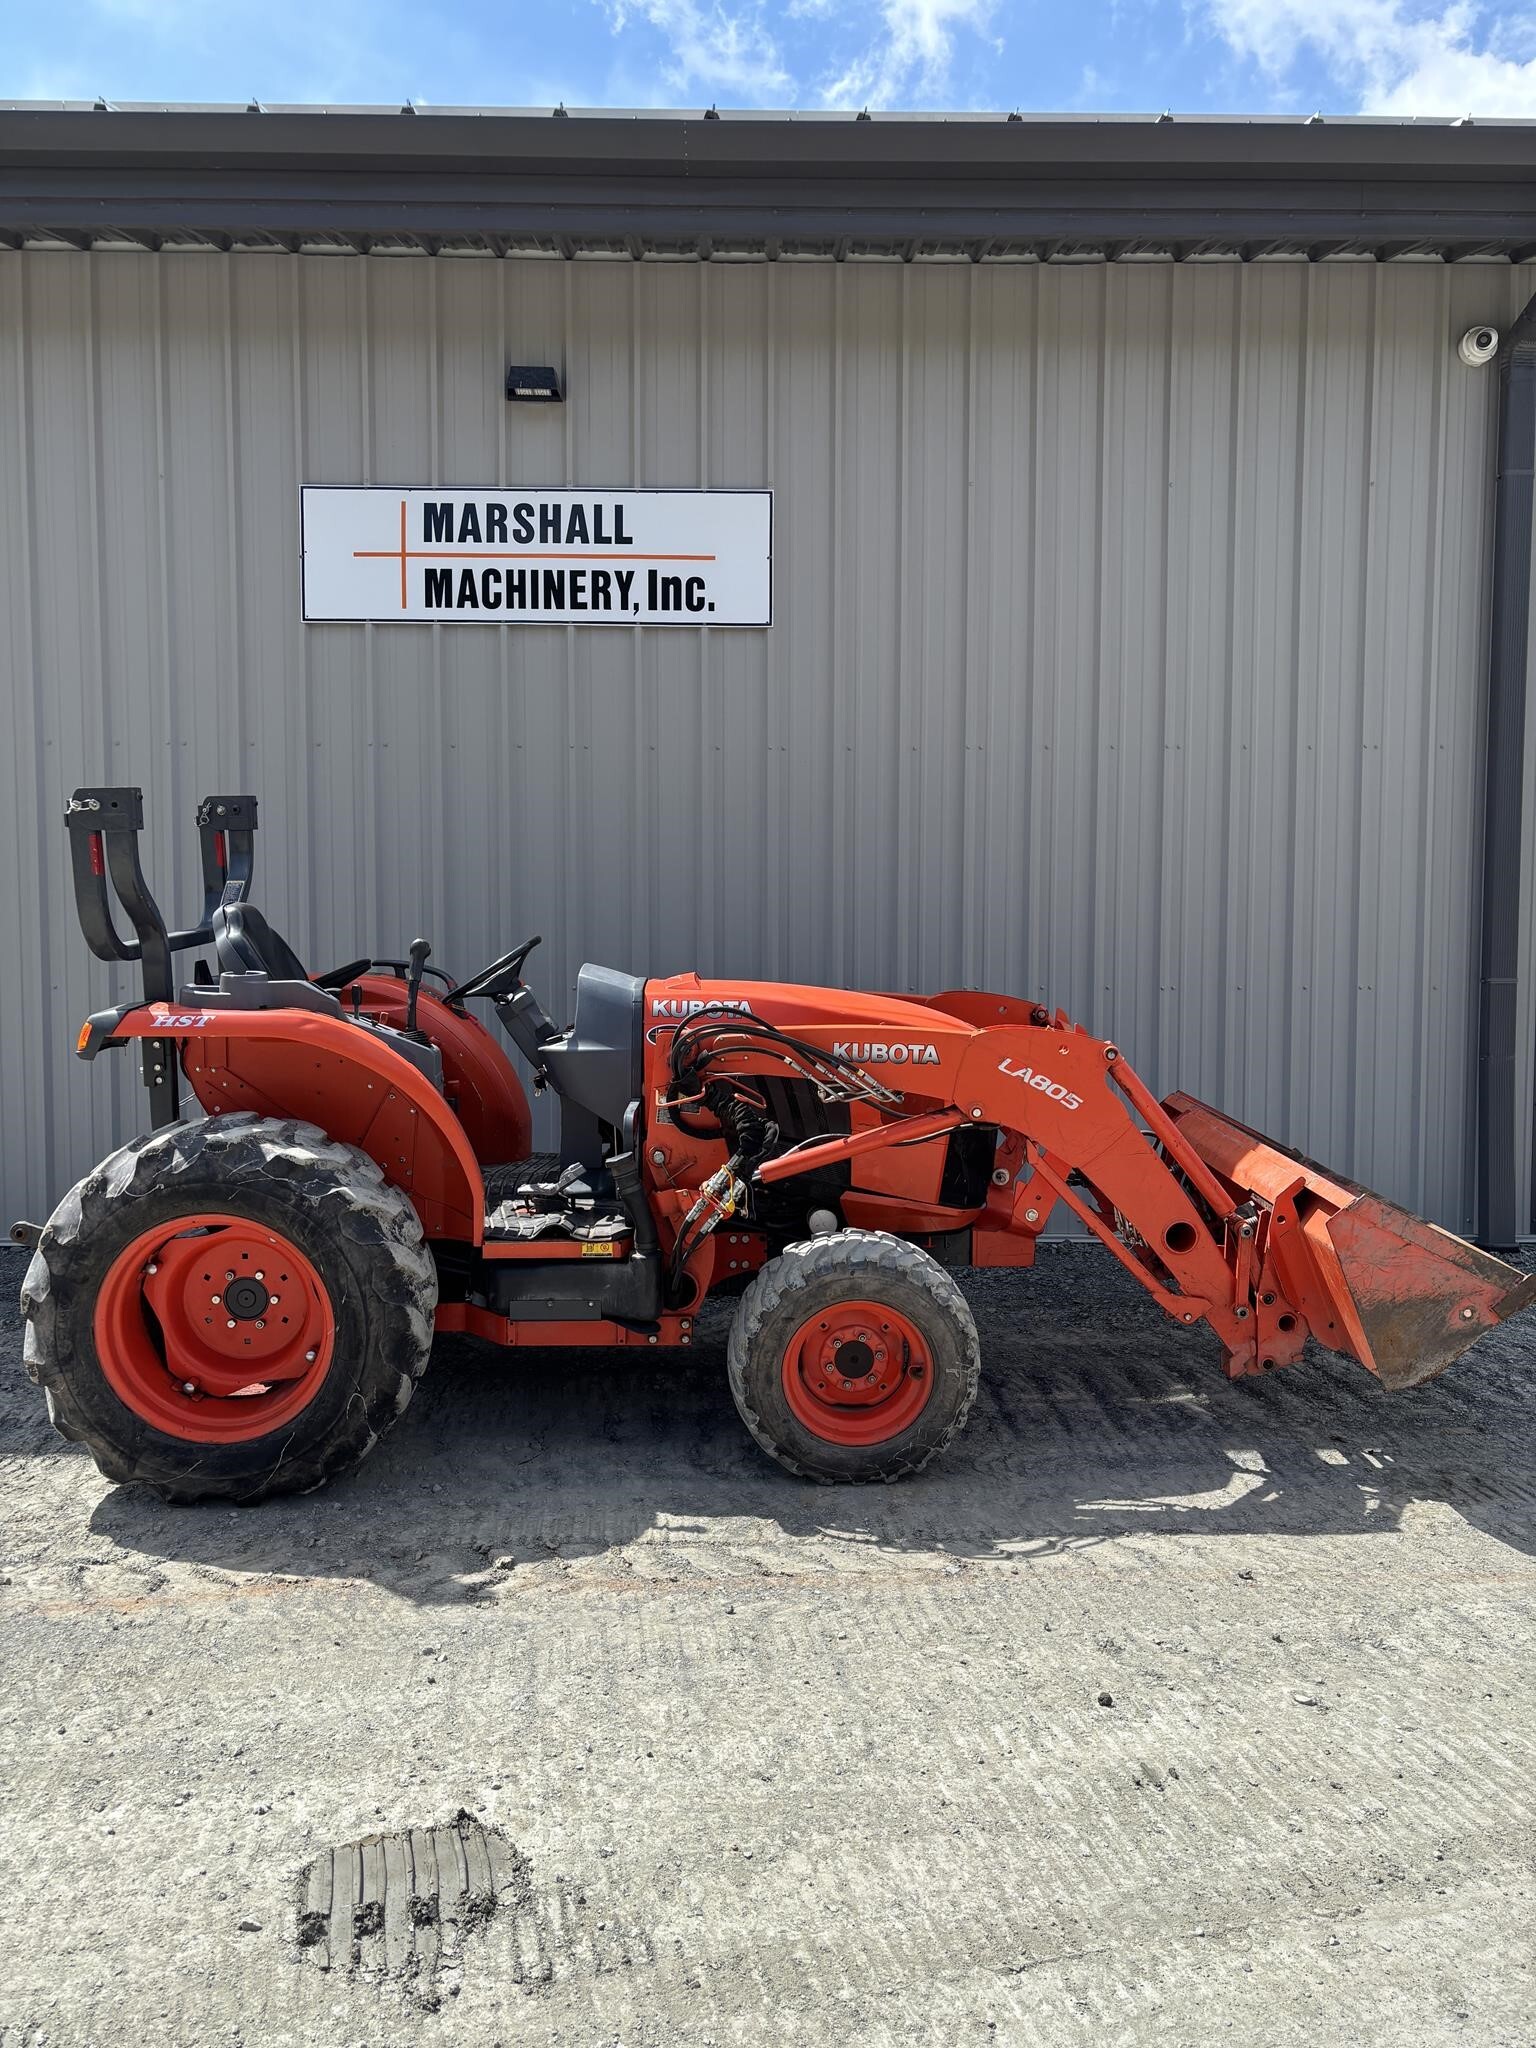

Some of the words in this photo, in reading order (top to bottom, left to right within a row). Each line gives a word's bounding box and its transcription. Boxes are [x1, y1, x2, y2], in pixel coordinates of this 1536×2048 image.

[423, 502, 633, 545] MARSHALL
[424, 568, 640, 616] MACHINERY,
[648, 569, 716, 612] Inc.
[150, 1015, 217, 1027] HST
[652, 999, 753, 1019] KUBOTA
[833, 1042, 941, 1065] KUBOTA
[997, 1057, 1084, 1110] LA805
